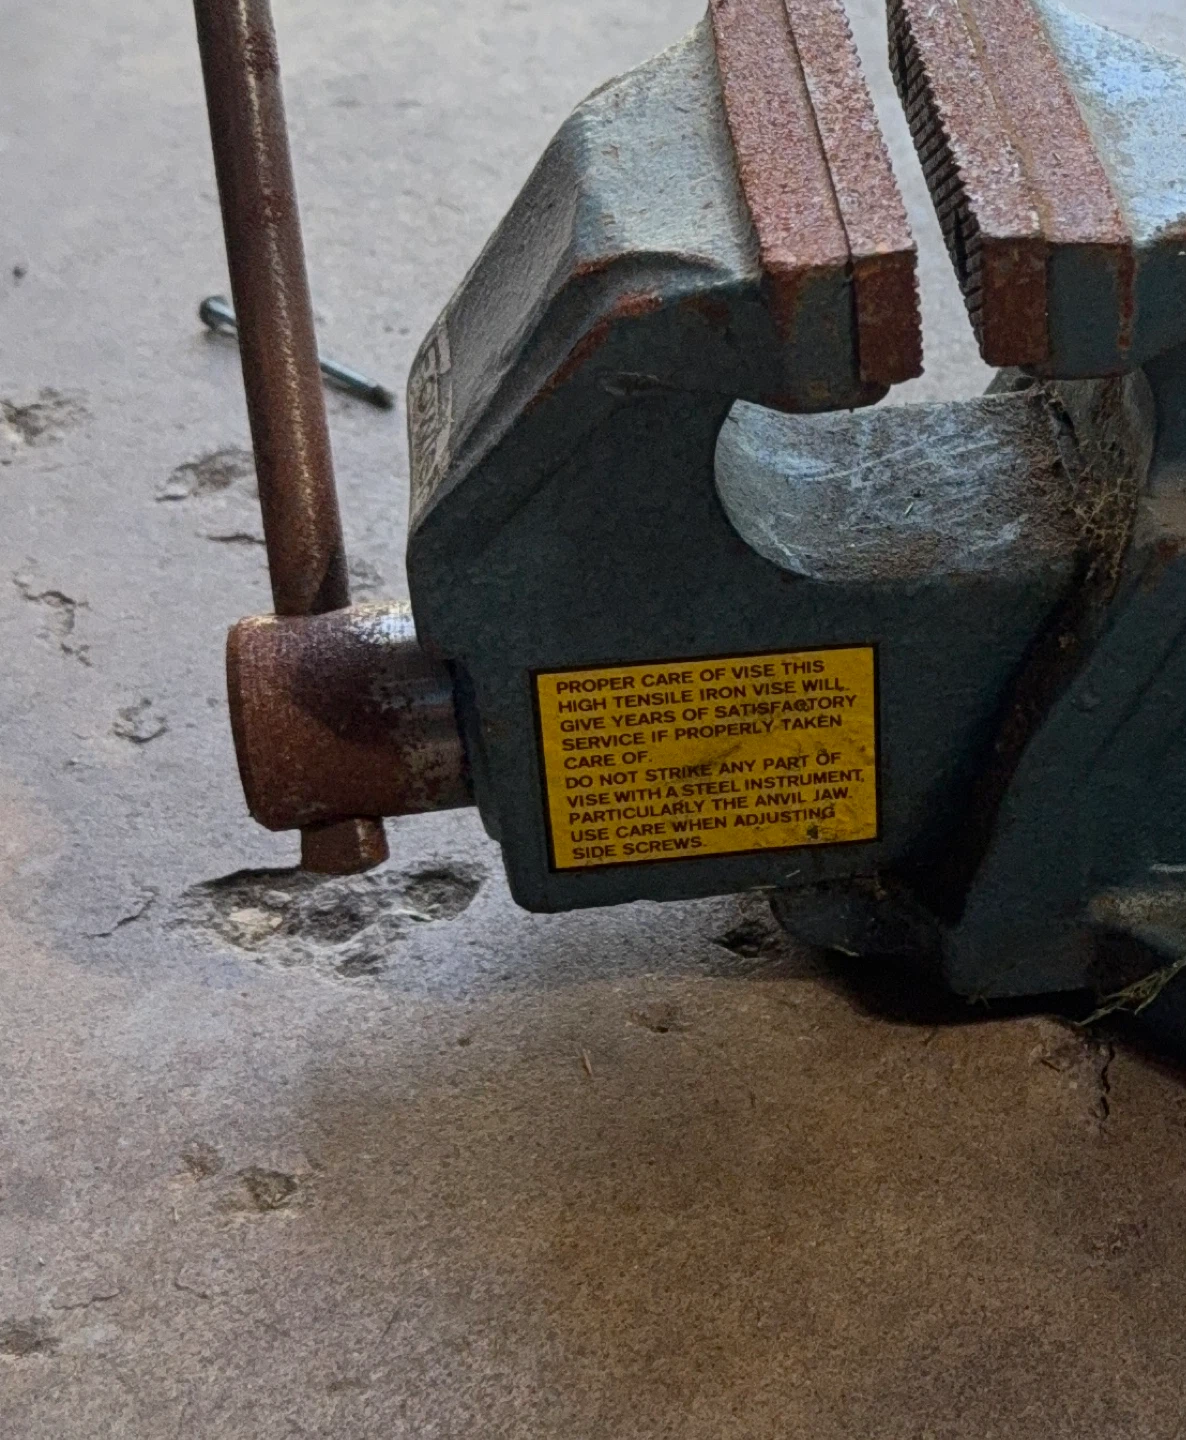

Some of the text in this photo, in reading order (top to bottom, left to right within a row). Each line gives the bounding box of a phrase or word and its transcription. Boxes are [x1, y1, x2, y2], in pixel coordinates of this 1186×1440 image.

[556, 660, 825, 695] PROPER CARE OF VISE THIS
[558, 697, 607, 714] HIGH
[613, 690, 694, 709] TENSILE
[700, 685, 747, 701] IRON
[752, 681, 797, 696] VISE
[560, 717, 606, 733] GIVE
[611, 710, 677, 728] YEARS
[682, 708, 710, 722] OF
[562, 714, 843, 752] SERVICE IF PROPERLY TAKEN
[564, 751, 653, 770] CARE OF.
[565, 752, 842, 789] DO NOT STRIKE ANY PART OF
[567, 769, 865, 808] VISE WITH A STEEL INSTRUMENT,
[569, 787, 853, 825] PARTICULARLY THE ANVIL JAW.
[571, 806, 836, 843] USE CARE WHEN ADJUSTING
[573, 836, 707, 860] SIDE SCREWS.
